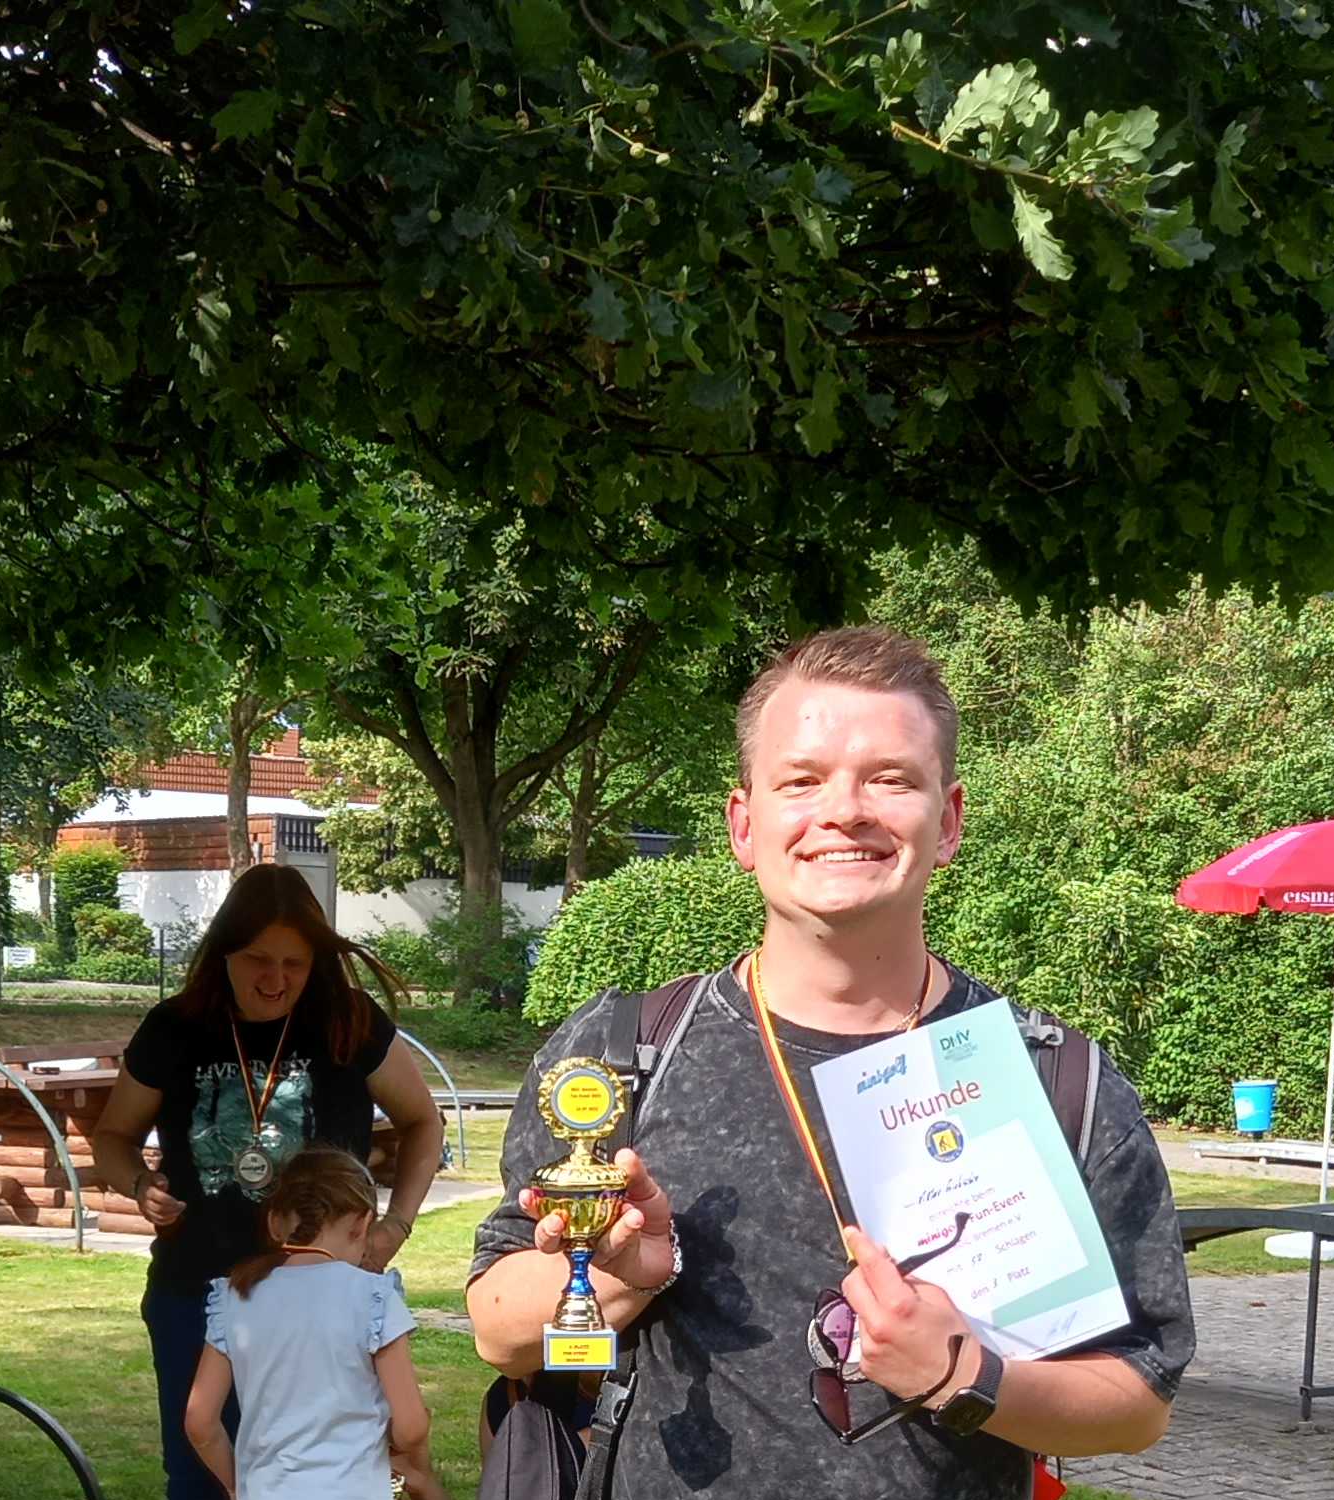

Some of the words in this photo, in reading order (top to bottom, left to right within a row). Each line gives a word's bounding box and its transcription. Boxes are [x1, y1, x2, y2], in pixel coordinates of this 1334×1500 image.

[195, 1061, 239, 1080] LIVE
[880, 1079, 982, 1131] Urkunde
[971, 1186, 996, 1202] beim
[917, 1223, 957, 1247] minigo
[968, 1191, 1026, 1223] Fun-Event
[972, 1221, 1006, 1241] Bremen
[971, 1286, 989, 1300] den
[1007, 1266, 1031, 1282] Platz
